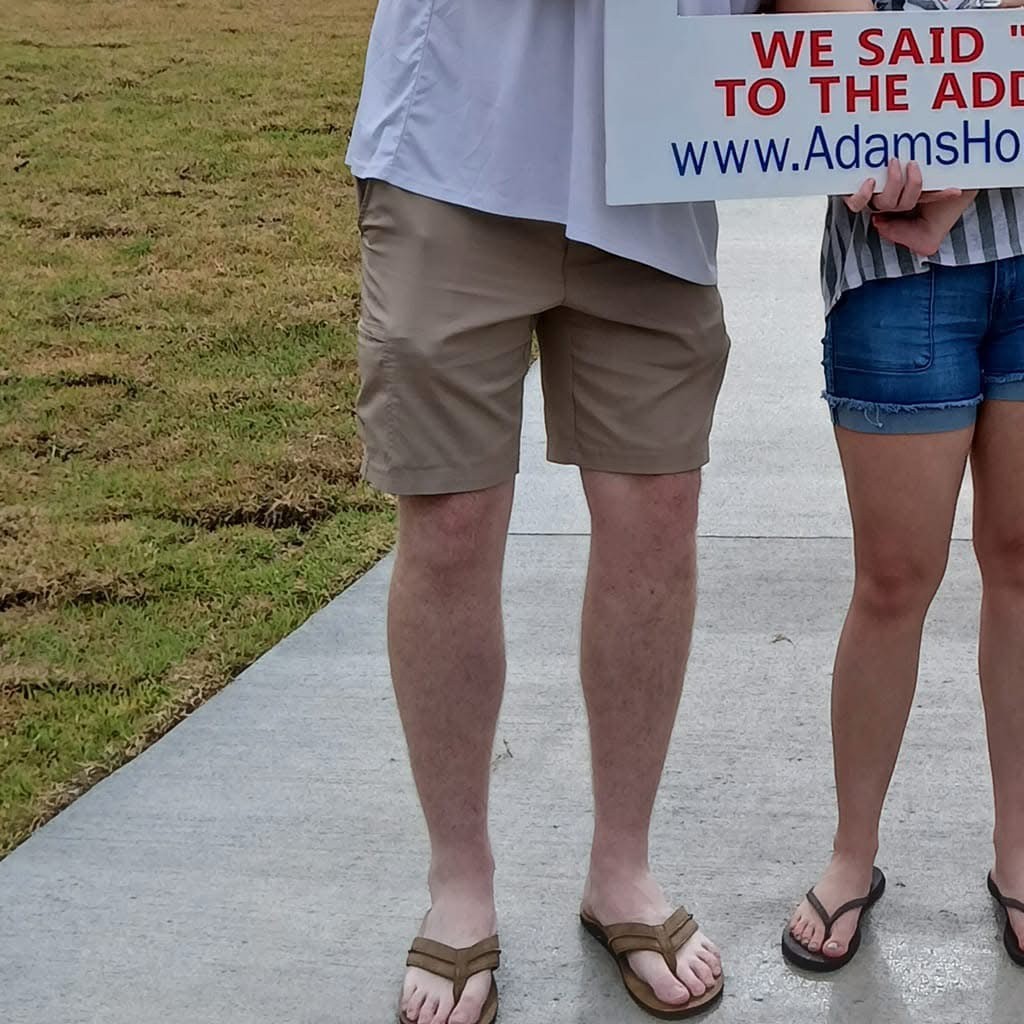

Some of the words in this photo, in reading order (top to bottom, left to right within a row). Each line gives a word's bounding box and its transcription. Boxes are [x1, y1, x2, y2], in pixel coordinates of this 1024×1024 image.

[751, 31, 834, 70] WE
[857, 27, 985, 67] SAID
[714, 79, 786, 117] TO
[810, 74, 909, 114] THE
